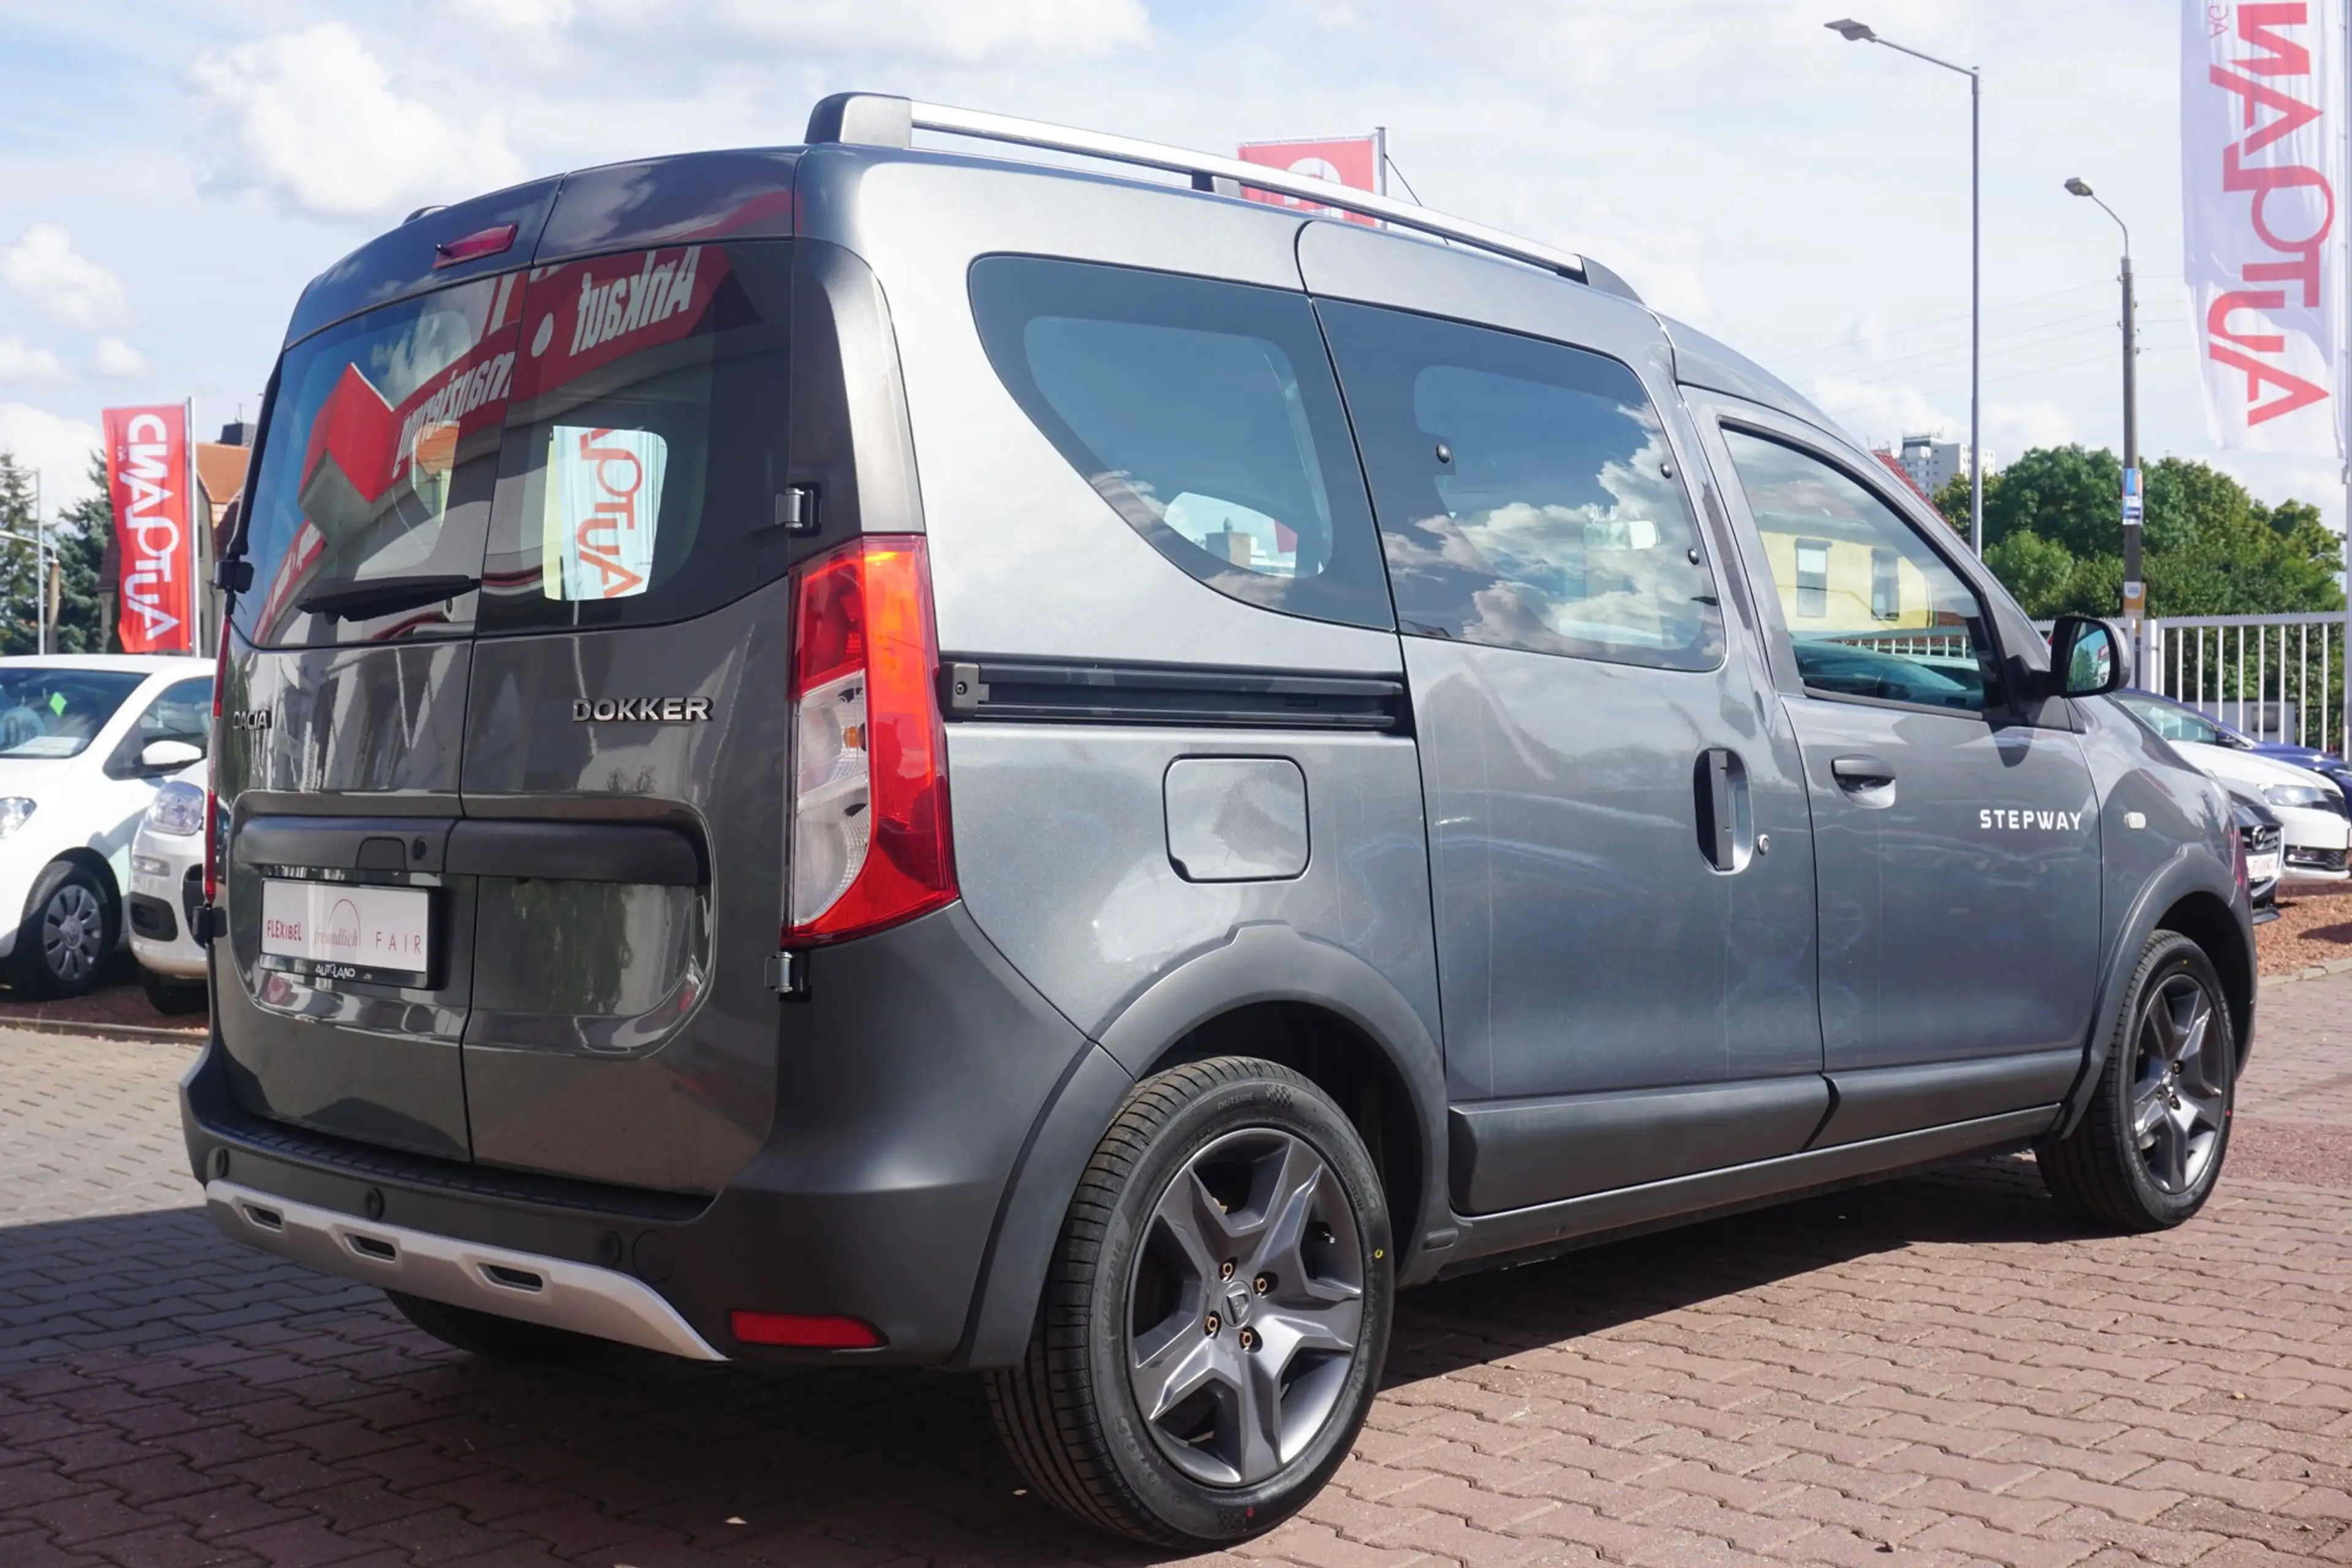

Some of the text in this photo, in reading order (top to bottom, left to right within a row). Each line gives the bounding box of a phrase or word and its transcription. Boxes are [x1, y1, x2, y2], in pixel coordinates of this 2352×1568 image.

[571, 696, 714, 722] DOKKER
[232, 710, 268, 730] DACIA
[1980, 810, 2082, 831] STEPWAY
[266, 919, 421, 955] FLEXIBEL freundlich FAIR
[314, 963, 356, 979] AUTOLAND
[1217, 1091, 1254, 1110] OUTSIDE
